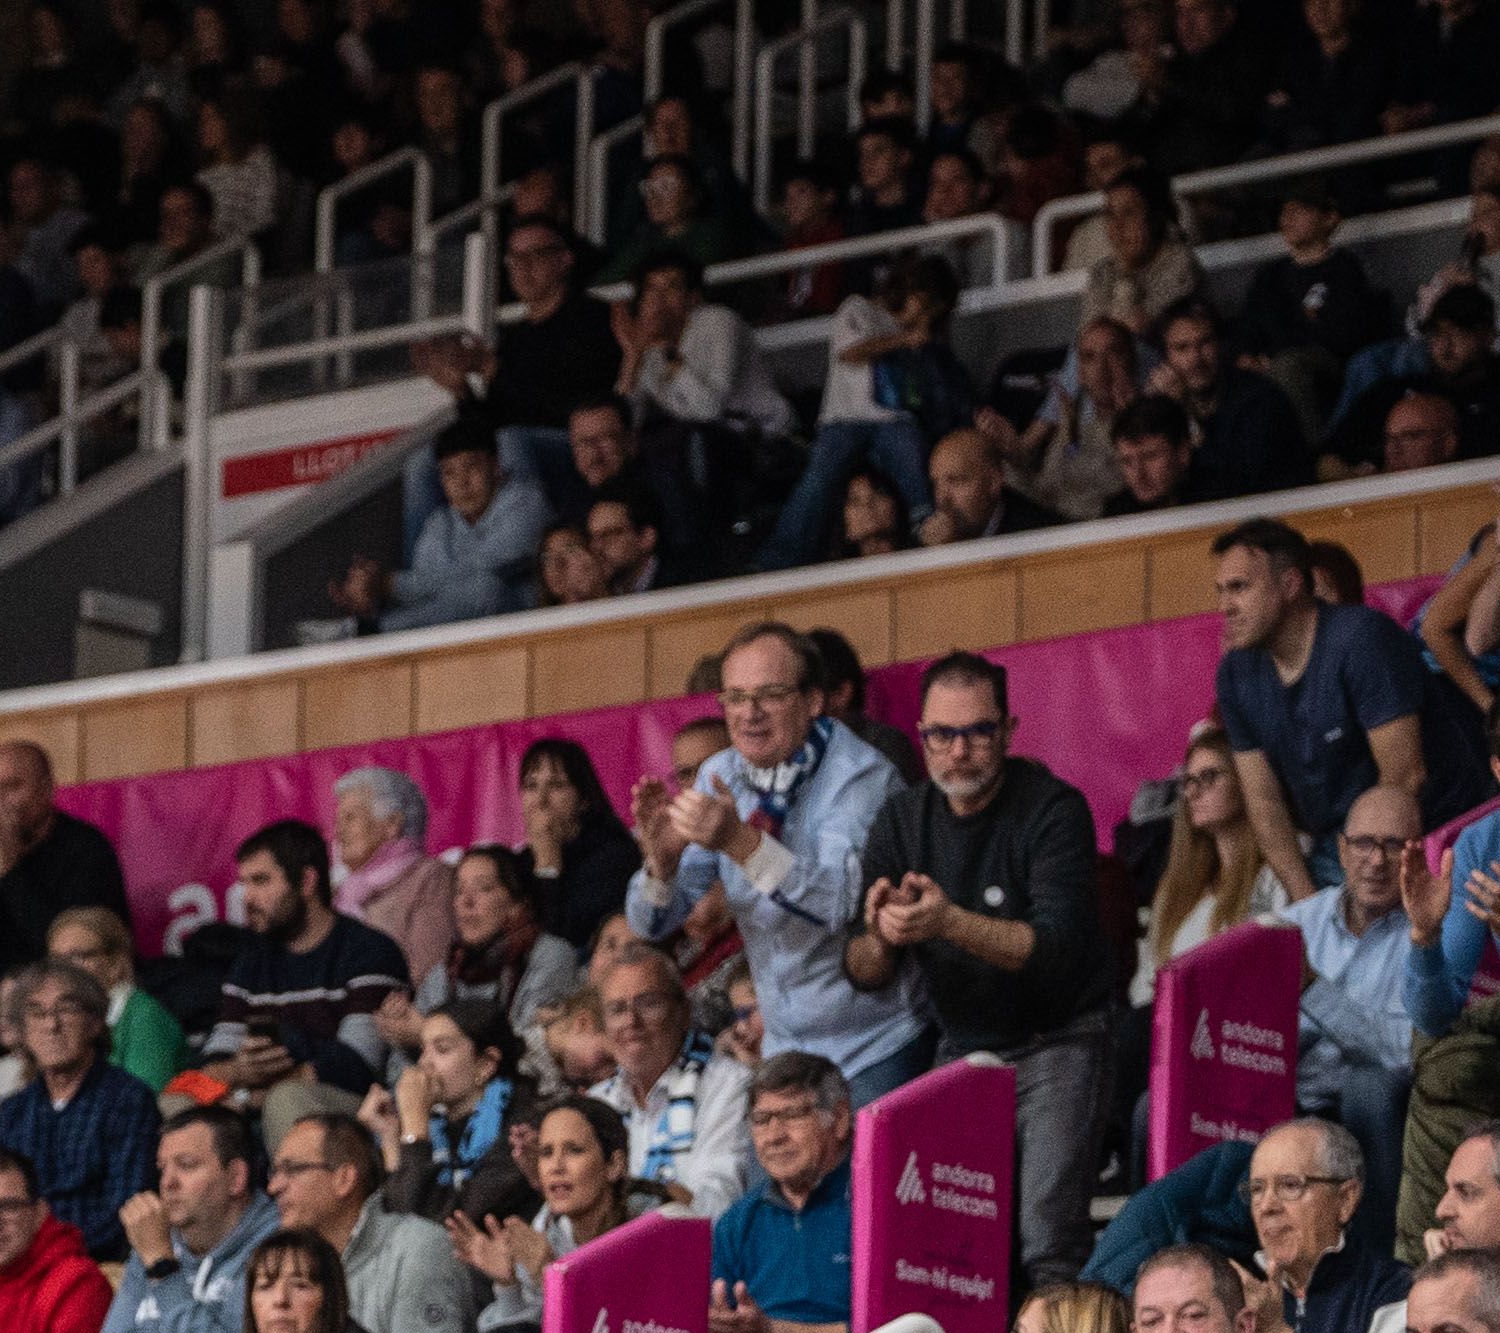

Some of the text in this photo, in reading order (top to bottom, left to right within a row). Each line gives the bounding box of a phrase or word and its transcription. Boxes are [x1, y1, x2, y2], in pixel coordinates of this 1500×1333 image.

[1221, 1019, 1284, 1049] andorra
[1221, 1043, 1287, 1074] telecom
[931, 1162, 996, 1193] andorra
[931, 1186, 998, 1220] telecom
